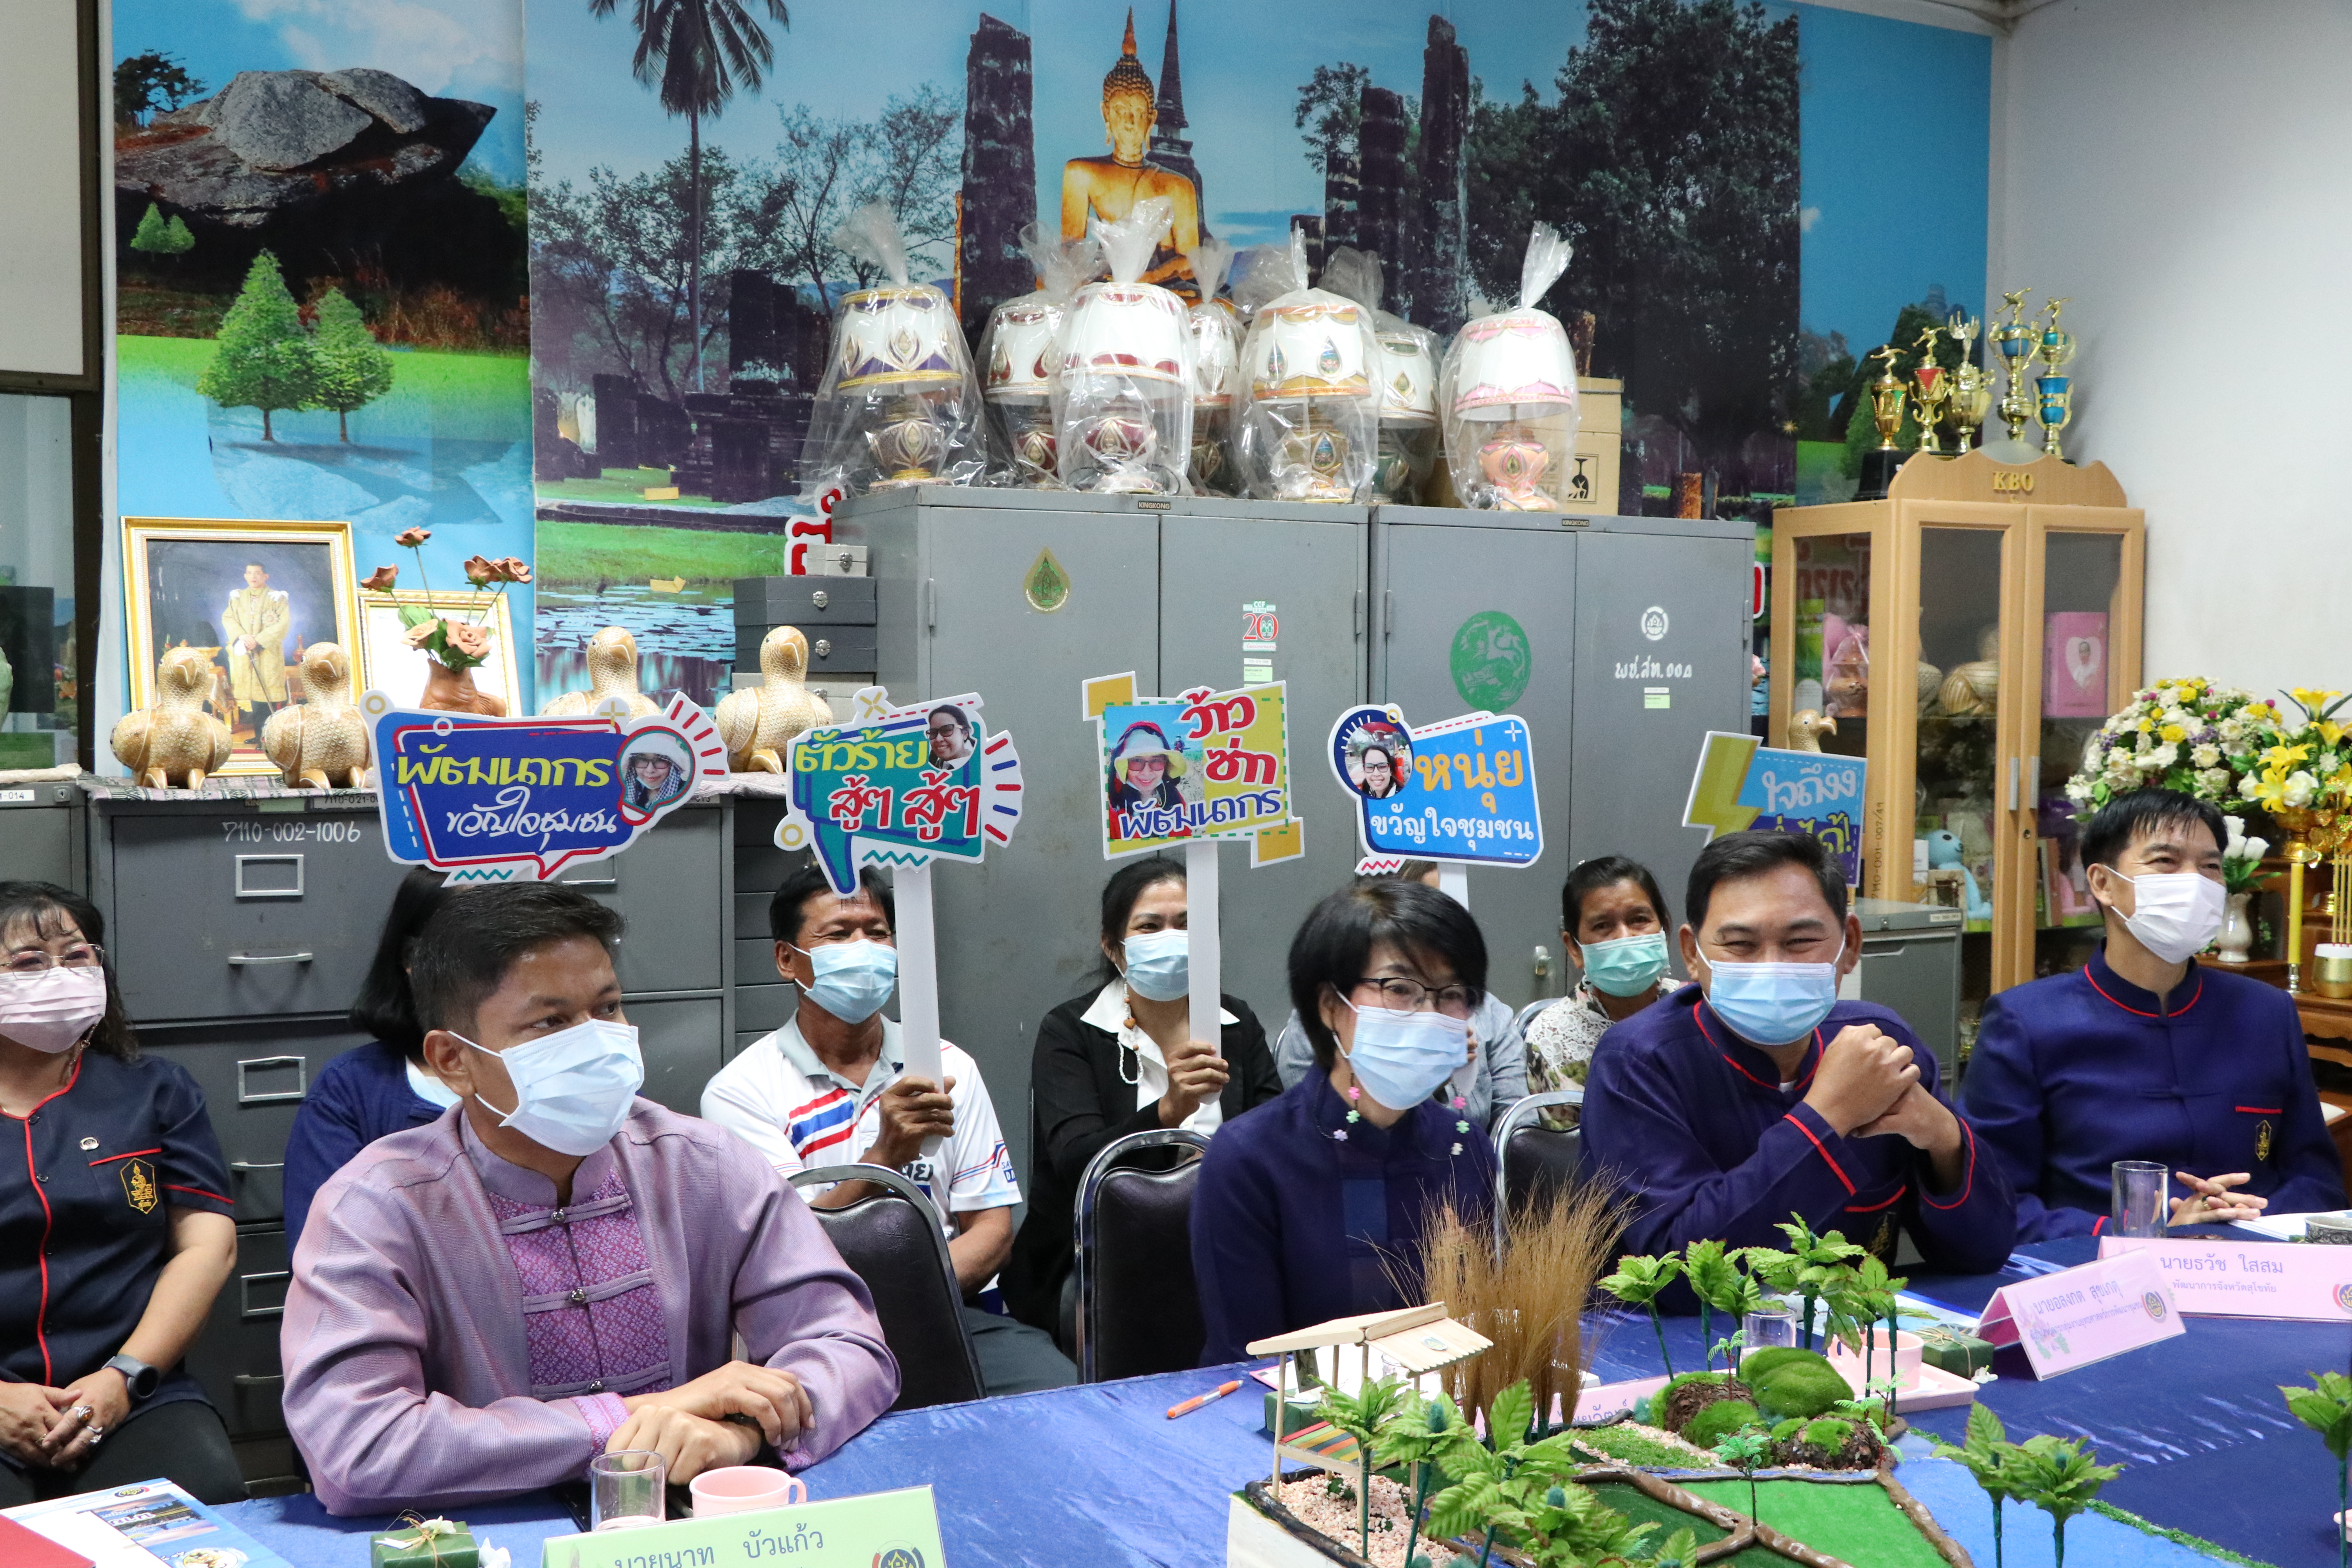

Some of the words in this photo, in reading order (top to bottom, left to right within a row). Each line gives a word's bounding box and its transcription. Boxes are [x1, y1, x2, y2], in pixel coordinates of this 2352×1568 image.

[1993, 472, 2034, 491] KBO
[1243, 612, 1278, 641] 20
[1181, 690, 1255, 739] ว้าว
[397, 744, 613, 786] พัฒนากร
[795, 729, 927, 772] ตัวร้าย
[1414, 728, 1524, 814] หนุ่ย
[222, 821, 361, 843] 7110-002-1006
[446, 786, 617, 851] ขวัญใจชุมชน
[1121, 790, 1282, 838] พัฒนากร
[1371, 803, 1534, 851] ขวัญใจชุมชน
[2160, 1253, 2227, 1271] นายธวัช
[2033, 1290, 2085, 1315] นายอลงกต
[2172, 1279, 2277, 1294] พัฒนาการจังหวัดสุโขทัย
[743, 1523, 824, 1559] บัวแก้ว
